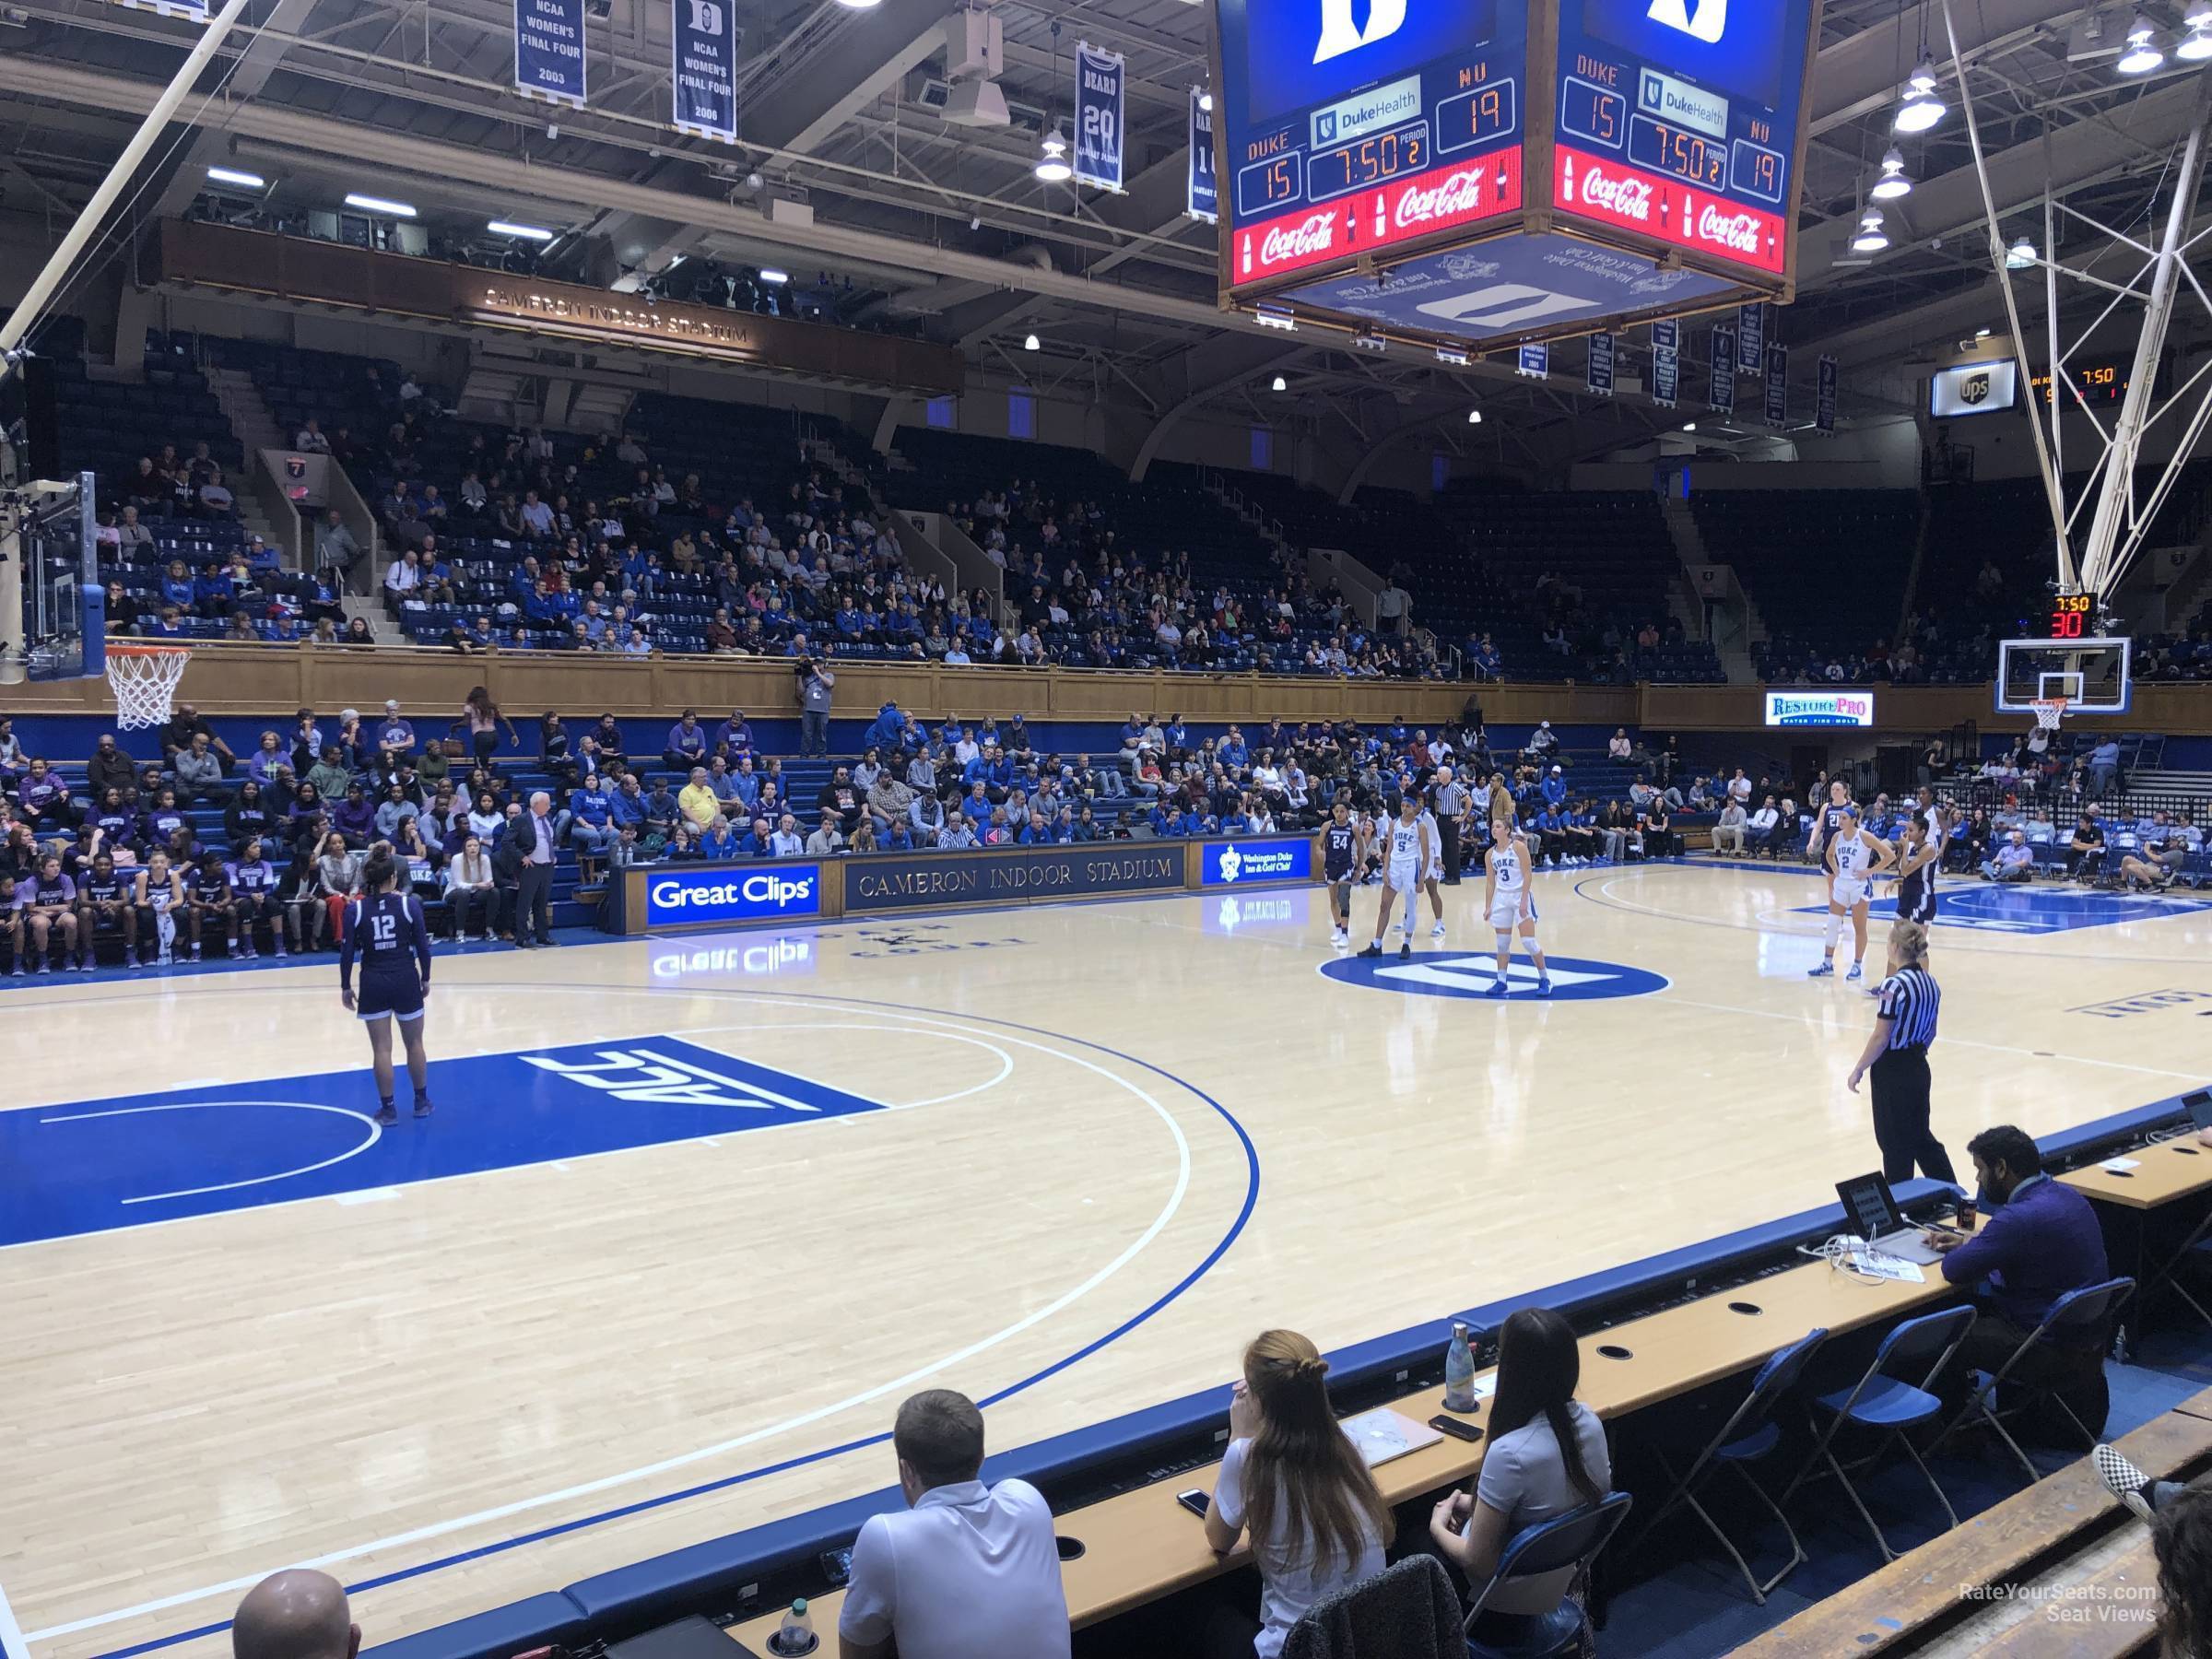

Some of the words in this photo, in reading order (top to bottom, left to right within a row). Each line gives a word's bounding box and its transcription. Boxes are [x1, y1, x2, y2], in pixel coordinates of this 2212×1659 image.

[535, 0, 564, 17] NCAA
[526, 16, 575, 39] WOMEN'S
[521, 33, 550, 51] FINAL
[553, 41, 581, 59] FOUR
[693, 41, 718, 57] NCAA
[539, 68, 565, 85] 2003
[684, 56, 727, 78] WOMEN'S
[1459, 62, 1487, 88] NU
[1577, 53, 1618, 87] DUKE
[679, 74, 707, 90] FINAL
[708, 80, 732, 96] FOUR
[1084, 70, 1116, 96] BEARD
[695, 106, 717, 121] 2006
[1342, 91, 1416, 129] DukeHealth
[1472, 90, 1500, 135] 19
[1593, 96, 1614, 139] 15
[1666, 92, 1724, 126] DukeHealth
[1084, 105, 1114, 138] 20
[1751, 120, 1771, 144] NU
[1248, 131, 1289, 160] DUKE
[1400, 128, 1426, 145] PERIOD
[1336, 134, 1397, 184] 7:50
[1409, 141, 1419, 164] 2
[1656, 125, 1704, 180] 7:50
[1706, 147, 1726, 163] PERIOD
[1267, 159, 1290, 199] 15
[1710, 161, 1719, 182] 2
[1755, 154, 1775, 192] 19
[1395, 167, 1485, 228] Coca-Cola
[1583, 167, 1653, 221] Coca-Cola
[1261, 209, 1337, 265] Coca-Cola
[1699, 205, 1761, 253] Coca-Cola
[485, 288, 582, 317] CAMERON
[589, 303, 661, 331] INDOOR
[667, 317, 747, 343] STADIUM
[2082, 368, 2114, 384] 7:50
[1961, 379, 1988, 404] ups
[291, 464, 300, 476] 7
[2056, 596, 2089, 611] 7:50
[2052, 612, 2082, 638] 30
[1333, 835, 1348, 850] 24
[1394, 832, 1414, 842] DUKE
[1398, 841, 1406, 852] 5
[1242, 854, 1277, 865] Washington
[1277, 853, 1293, 861] Duke
[1837, 846, 1858, 857] DUKE
[1842, 856, 1850, 868] 2
[409, 870, 432, 881] UKE
[1263, 864, 1276, 872] Golf
[1277, 862, 1291, 871] Club
[1493, 859, 1514, 869] DUKE
[1501, 869, 1510, 882] 3
[858, 870, 977, 898] CAMERON
[989, 864, 1072, 889] INDOOR
[1086, 858, 1172, 882] STADIUM
[652, 880, 737, 910] Great
[743, 876, 811, 909] Clips
[371, 915, 396, 940] 12
